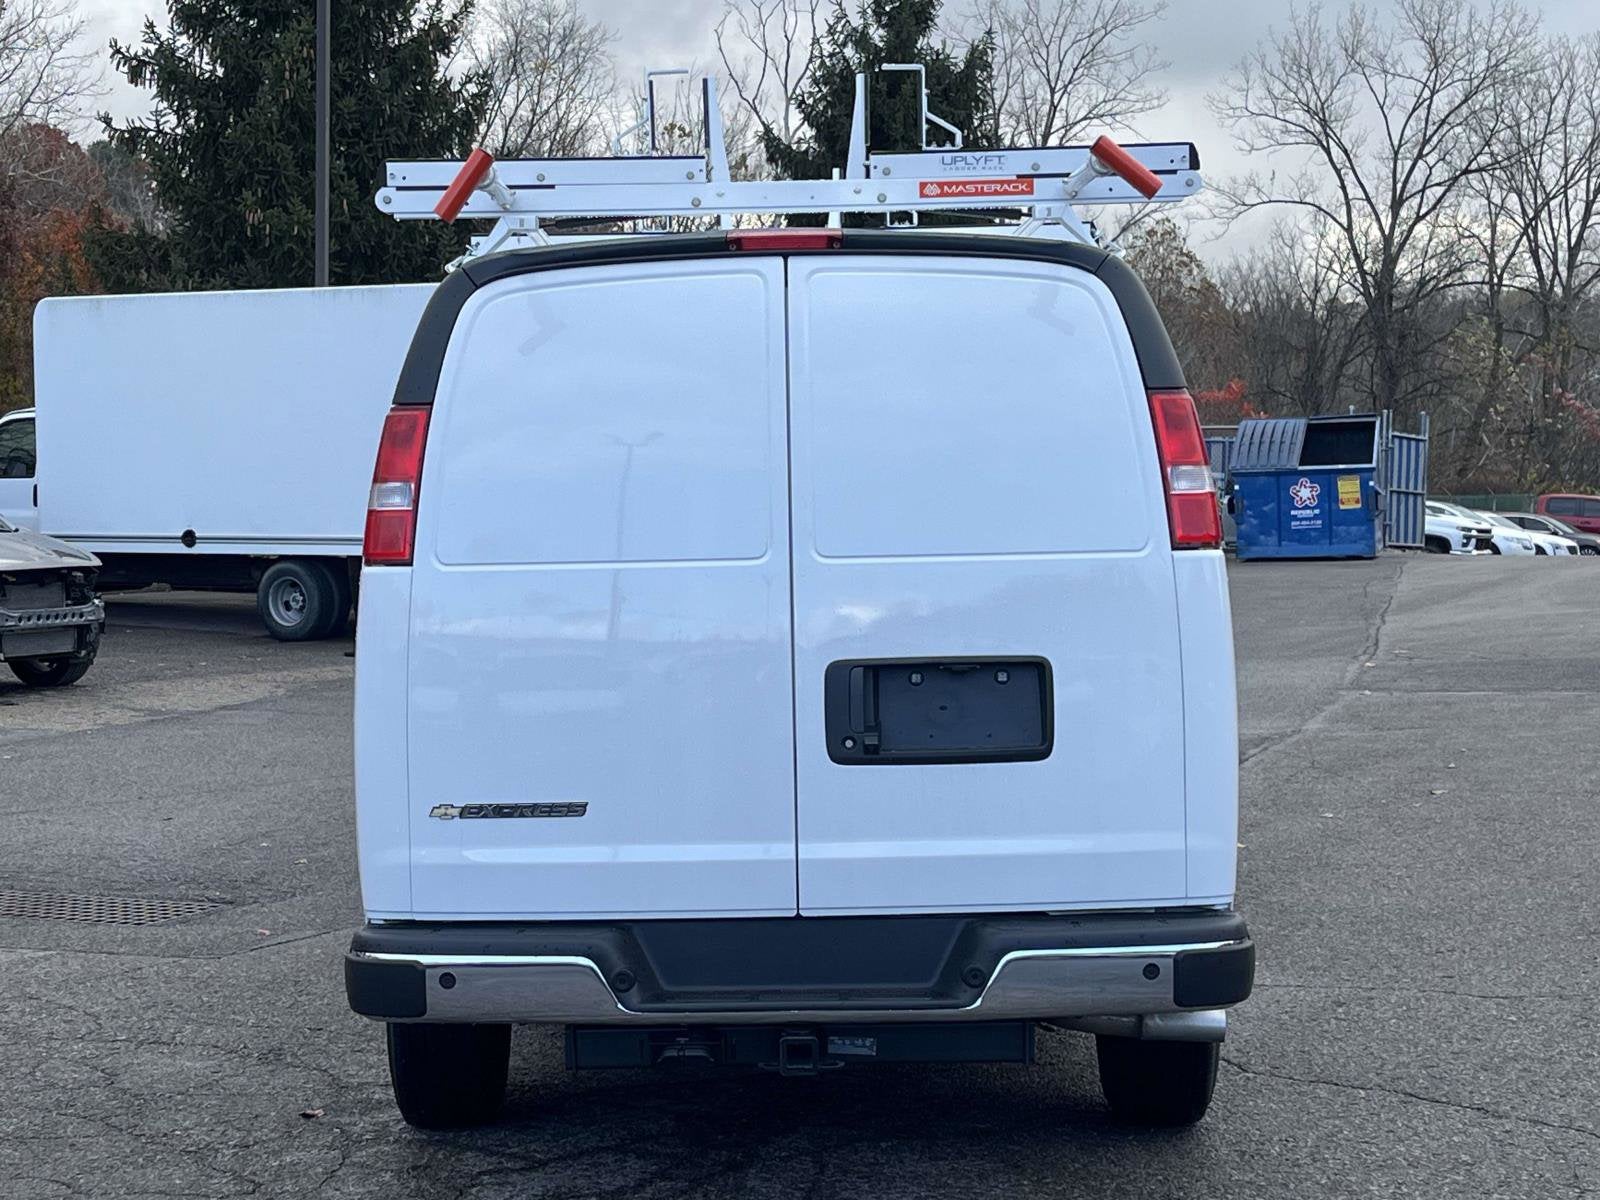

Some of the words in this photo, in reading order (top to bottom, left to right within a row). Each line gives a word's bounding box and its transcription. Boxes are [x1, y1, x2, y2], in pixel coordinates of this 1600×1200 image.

[941, 155, 1005, 166] UPLYFT
[943, 183, 1030, 194] MASTERACK
[461, 802, 588, 818] EXPRESS
